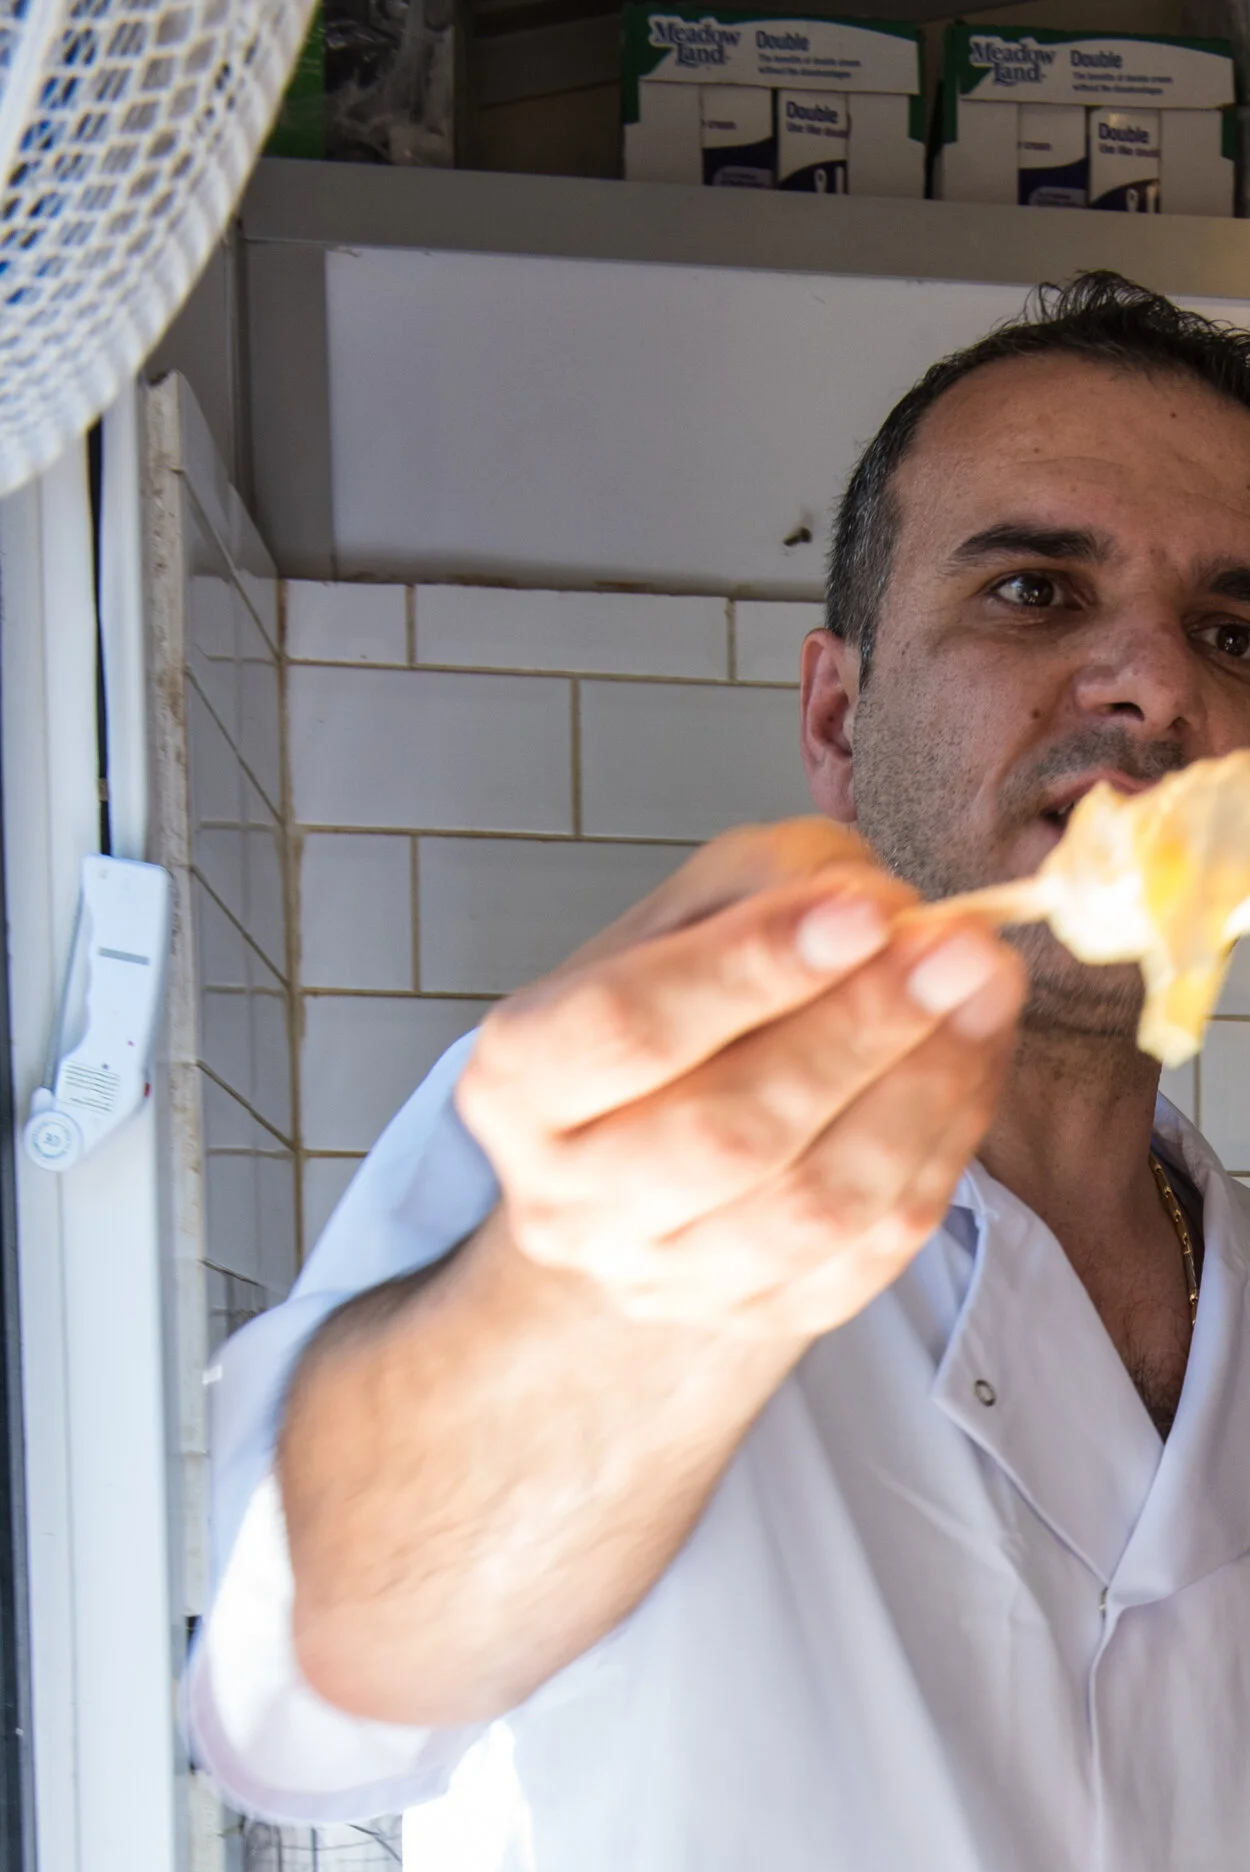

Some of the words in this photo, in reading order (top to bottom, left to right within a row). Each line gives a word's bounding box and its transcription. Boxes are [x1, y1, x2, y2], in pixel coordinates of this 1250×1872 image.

[652, 21, 741, 46] Meadow
[756, 31, 810, 52] Double
[676, 42, 726, 68] Land
[970, 42, 1056, 65] Meadow
[1070, 49, 1123, 69] Double
[994, 62, 1043, 87] Land
[785, 101, 838, 125] Double
[1098, 122, 1150, 144] Double
